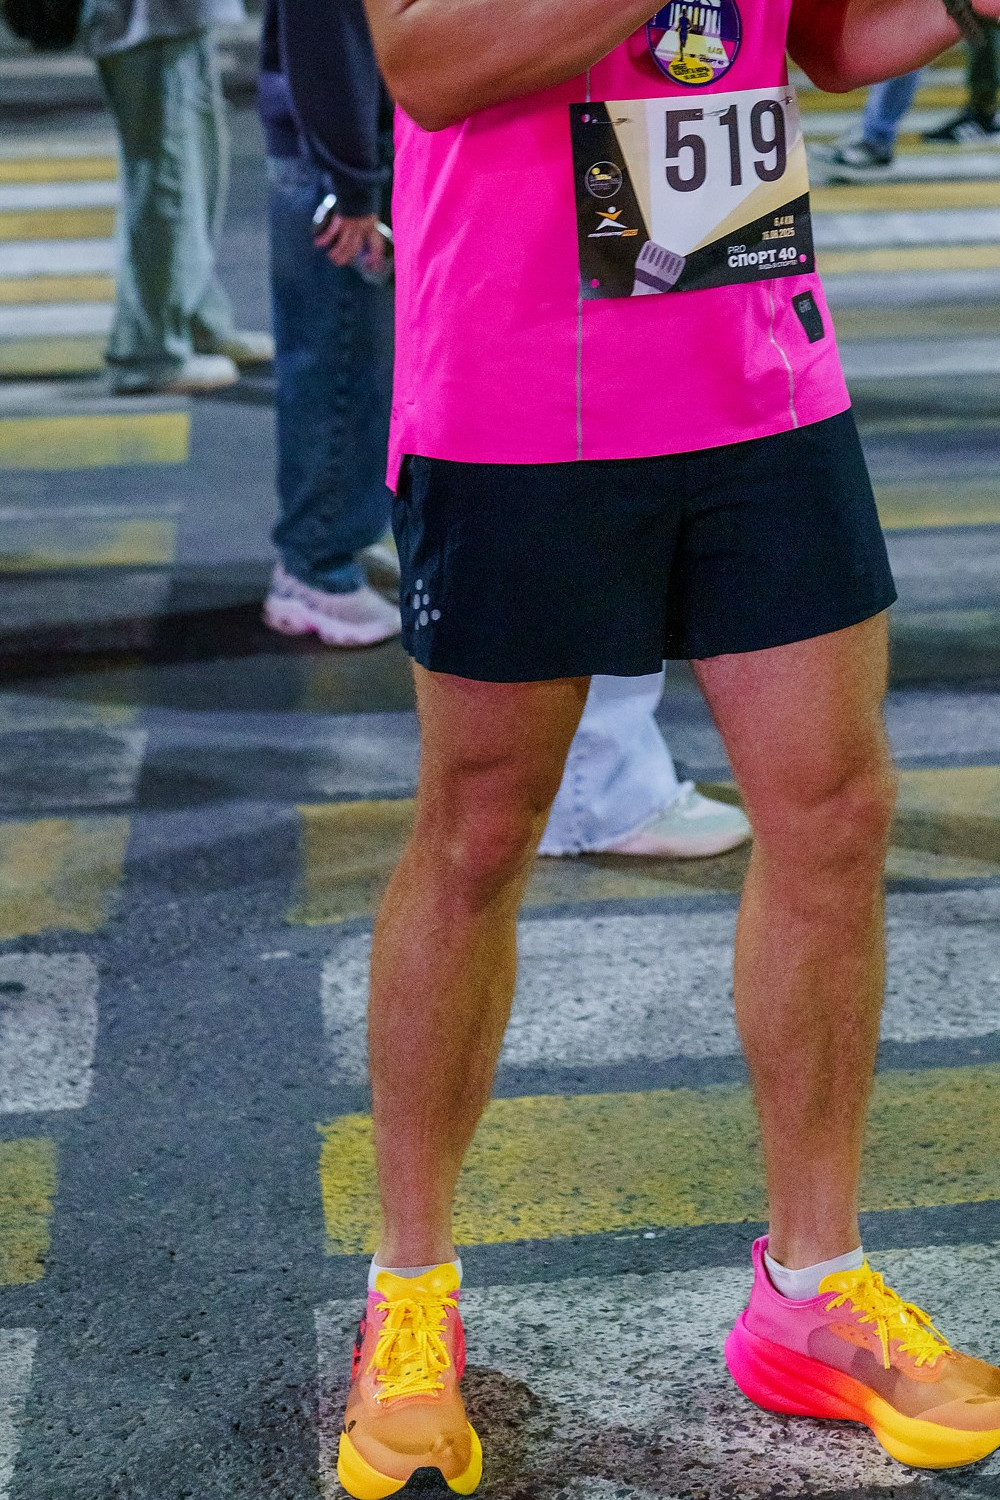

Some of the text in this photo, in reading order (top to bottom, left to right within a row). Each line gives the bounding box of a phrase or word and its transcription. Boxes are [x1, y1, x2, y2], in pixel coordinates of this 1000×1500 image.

[665, 99, 786, 192] 519
[727, 244, 747, 255] PRO
[727, 249, 777, 268] СПОРТ
[778, 246, 797, 260] 40
